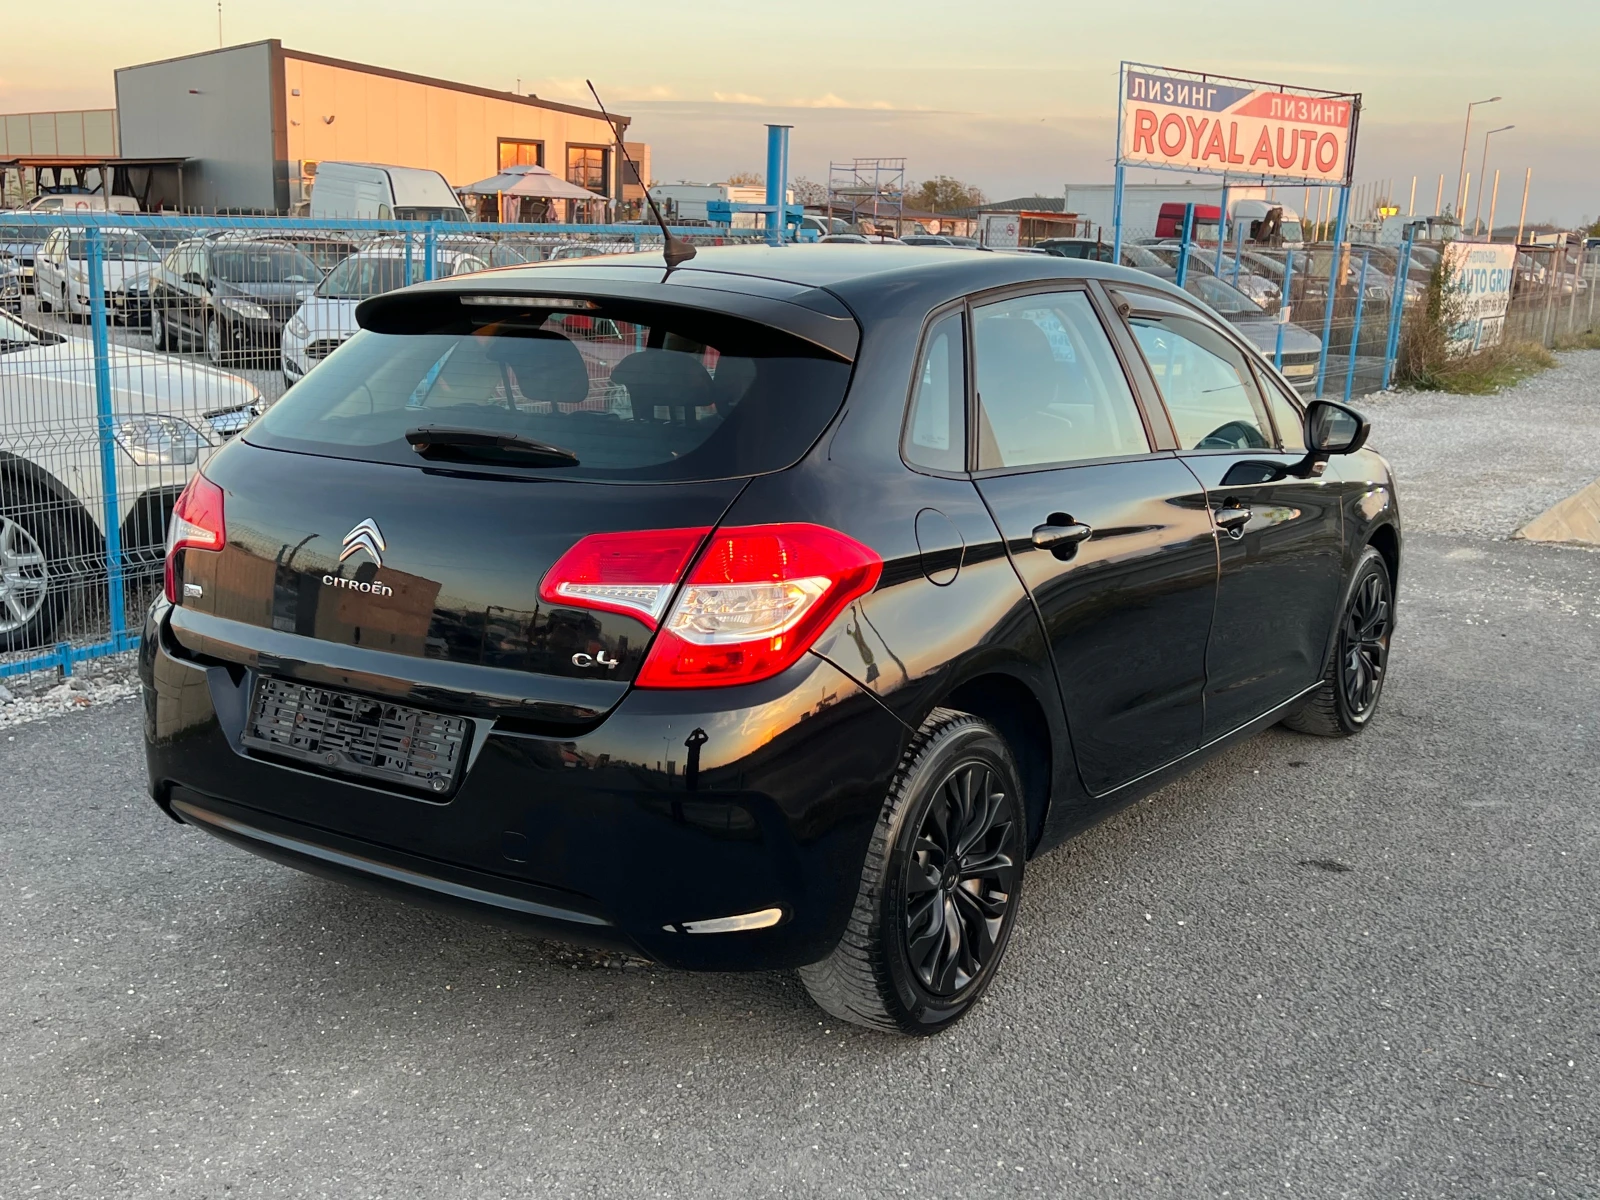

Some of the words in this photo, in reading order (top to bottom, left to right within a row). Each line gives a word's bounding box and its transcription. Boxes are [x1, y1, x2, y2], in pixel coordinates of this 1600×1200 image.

[1132, 78, 1217, 108] ЛИЗИНГ
[1270, 98, 1346, 124] ЛИЗИНГ
[1133, 109, 1244, 163] ROYAL
[1249, 125, 1338, 172] AUTO
[571, 651, 619, 669] C4
